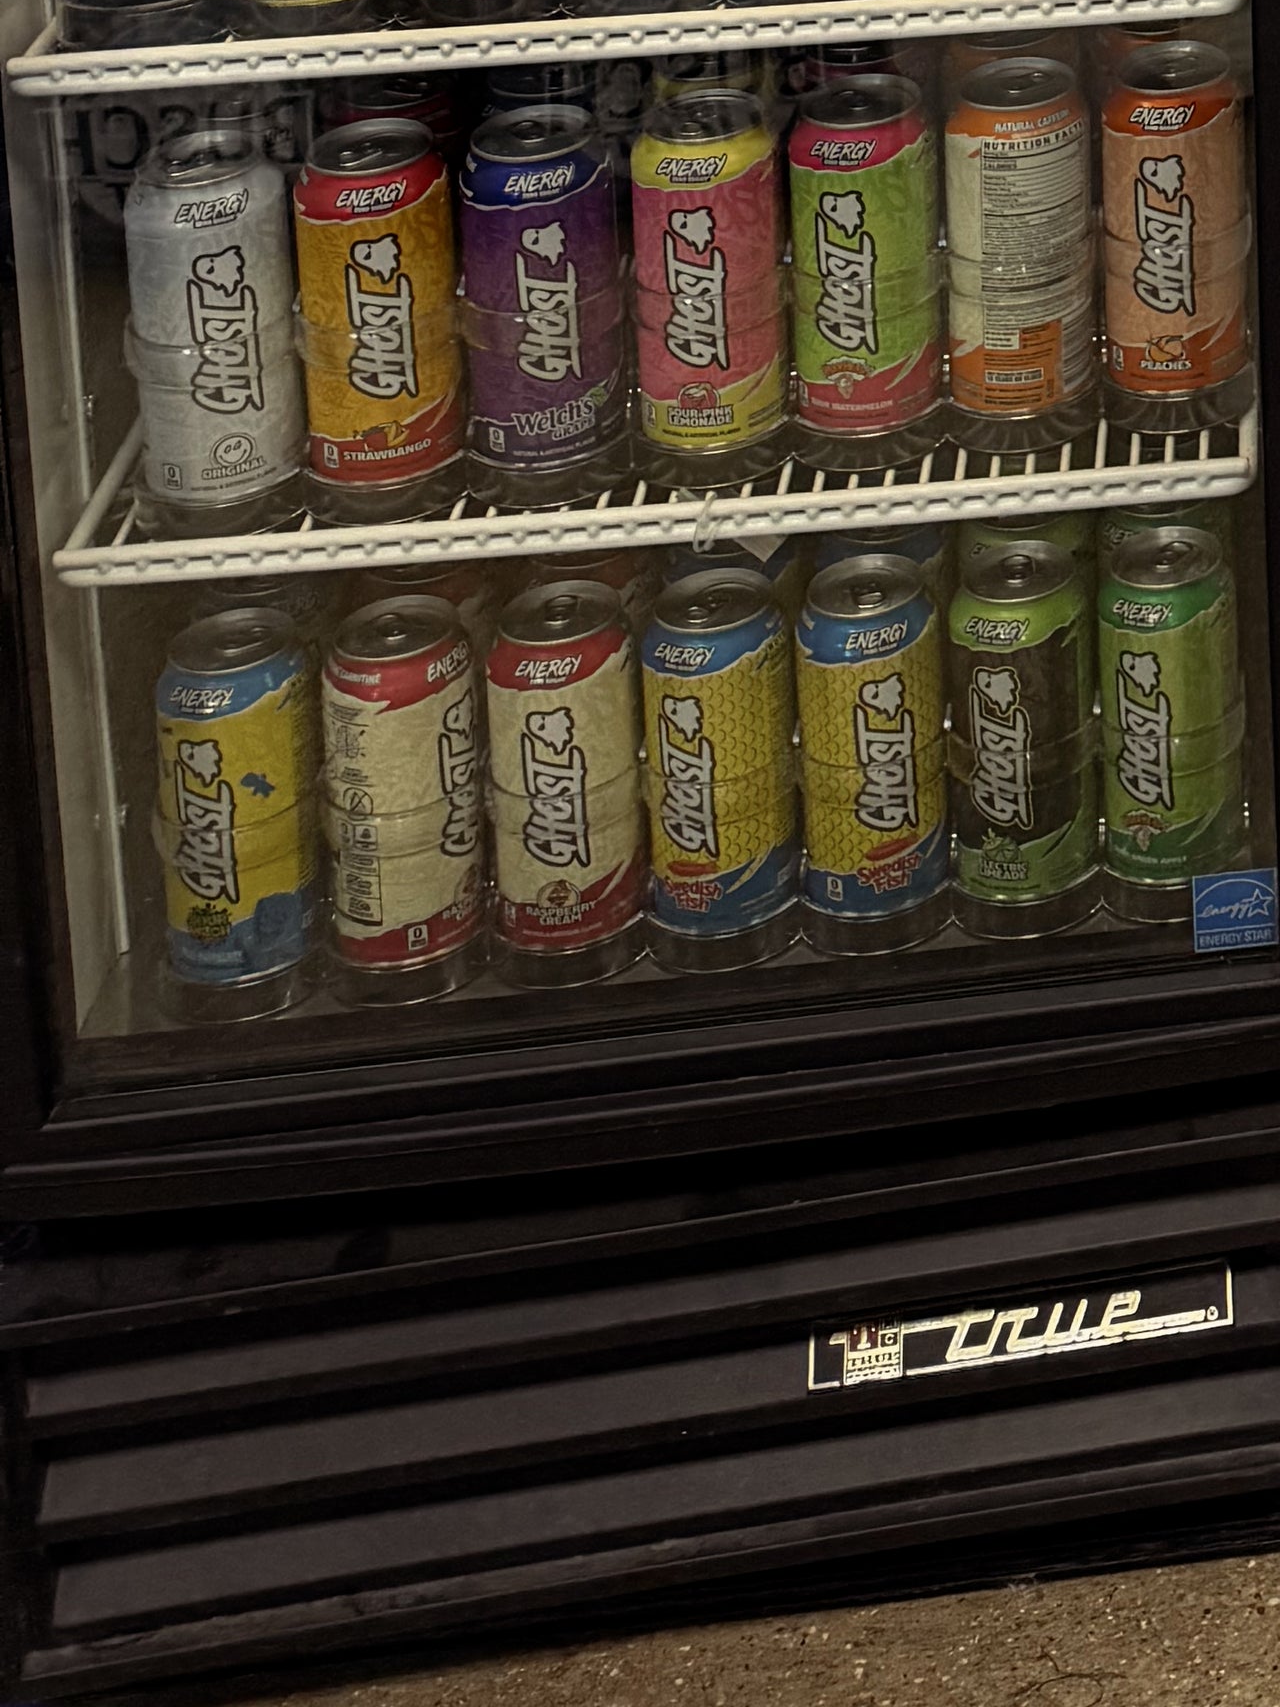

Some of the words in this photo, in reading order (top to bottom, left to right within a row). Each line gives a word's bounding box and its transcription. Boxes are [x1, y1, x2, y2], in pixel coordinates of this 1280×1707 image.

[1129, 103, 1196, 128] ENERGY
[810, 139, 878, 164] ENERGY
[504, 163, 576, 195] ENERGY
[655, 154, 729, 181] ENERGY
[174, 190, 250, 227] ENERGY
[335, 180, 408, 210] ENERGY
[815, 215, 875, 355] GHOST
[664, 235, 730, 370] GHOST
[516, 252, 581, 382] GHOST
[348, 265, 419, 399] GHOST
[187, 279, 264, 415] GHOST
[1139, 357, 1192, 372] PEACHES
[510, 394, 594, 434] Welch's
[550, 414, 595, 441] GRAPE
[668, 415, 733, 428] LEMONADE
[342, 438, 433, 463] STRAWBANGO
[201, 456, 266, 481] ORIGINAL
[856, 852, 924, 887] Swedish
[874, 870, 912, 894] Fish
[525, 899, 597, 925] RASPBERRY
[675, 893, 710, 913] Fish
[539, 911, 584, 928] CREAM
[1199, 931, 1243, 947] ENERGY
[1244, 928, 1273, 943] STAR
[944, 1290, 1141, 1362] True
